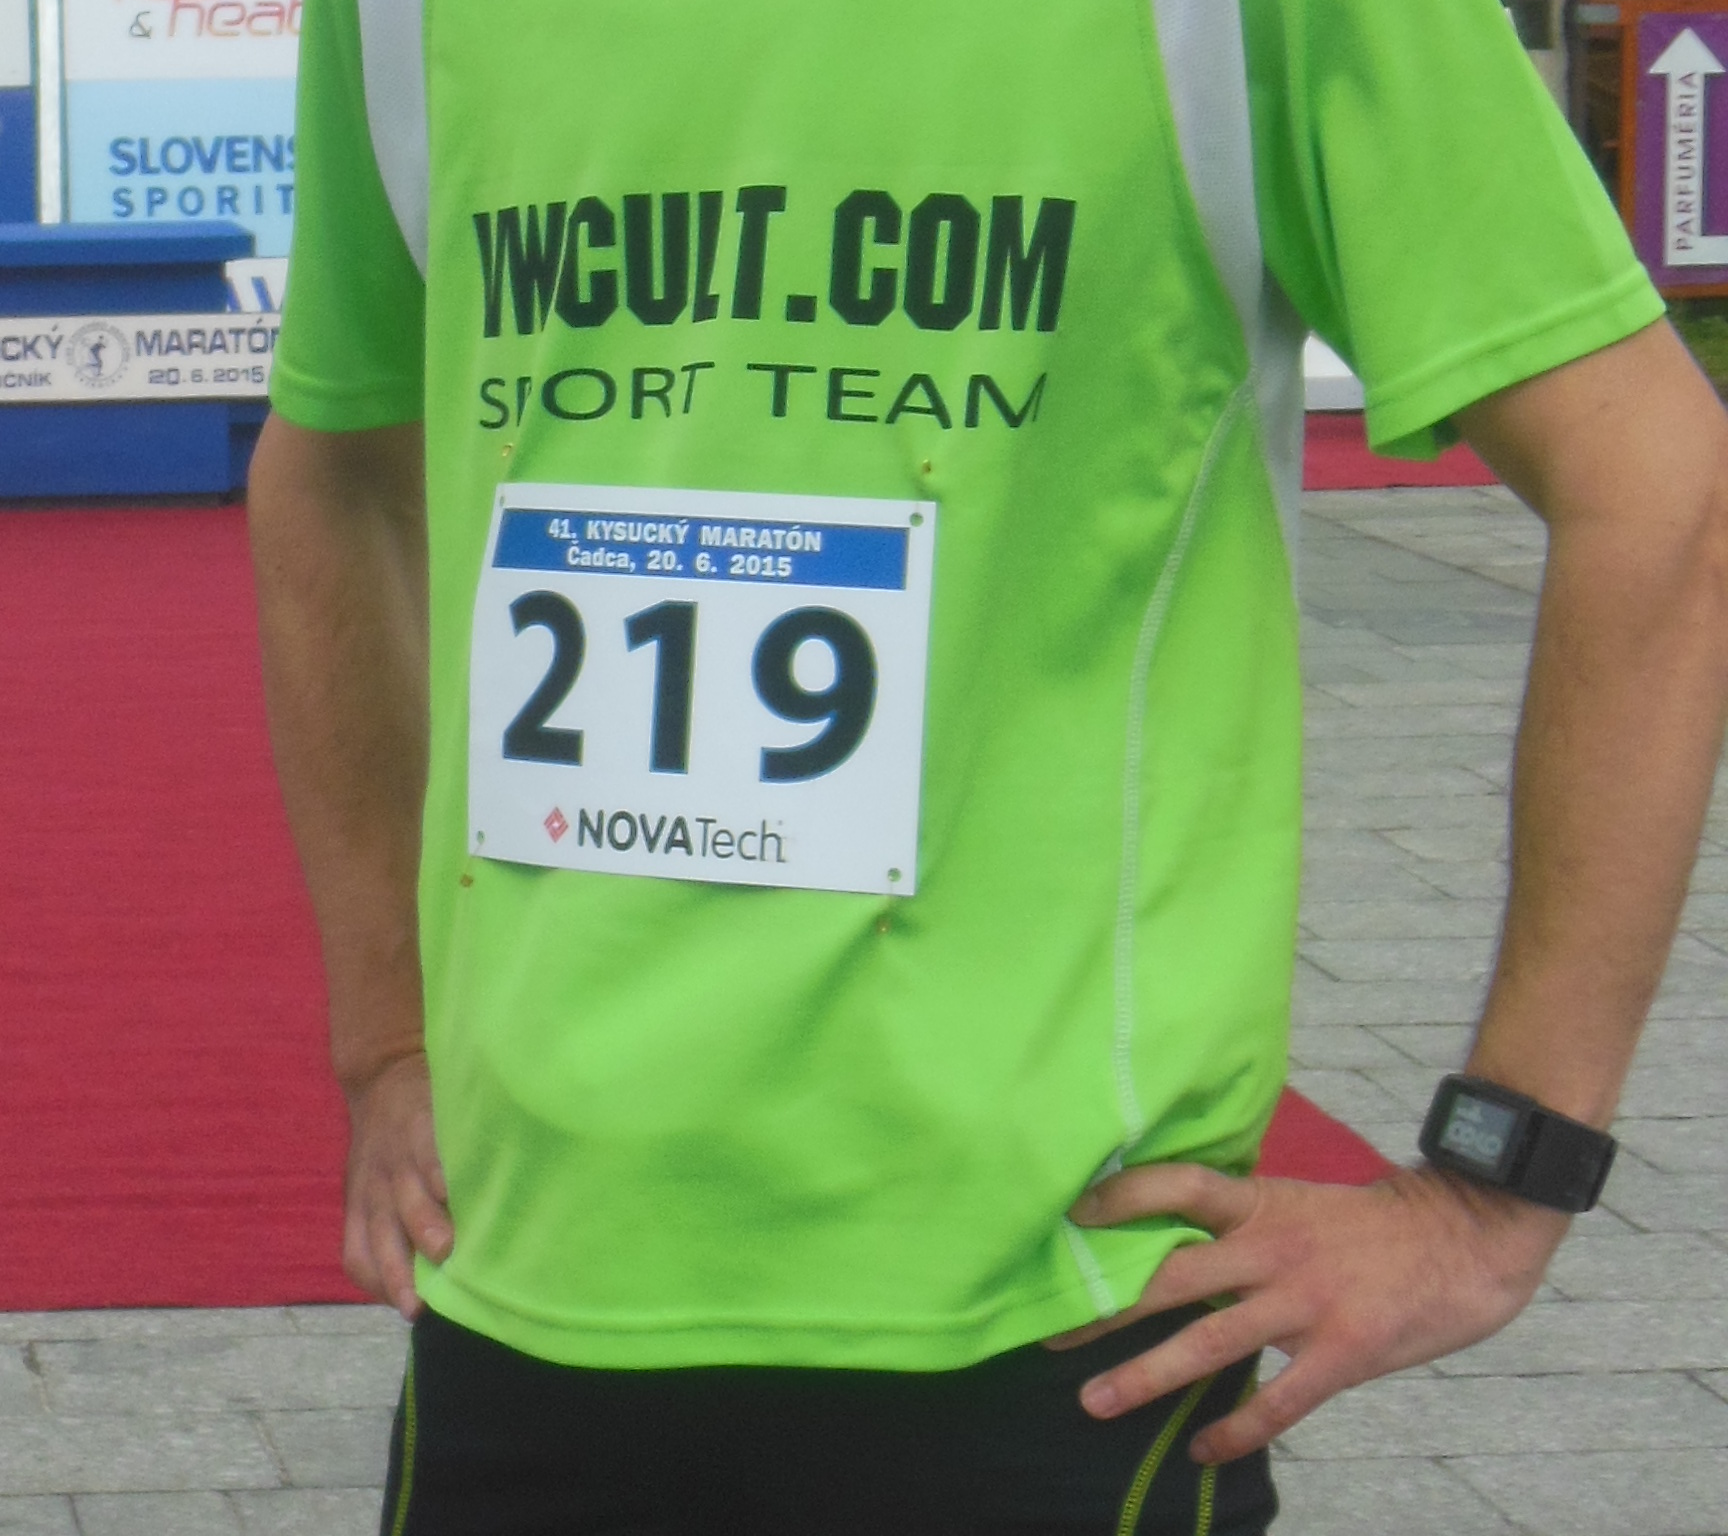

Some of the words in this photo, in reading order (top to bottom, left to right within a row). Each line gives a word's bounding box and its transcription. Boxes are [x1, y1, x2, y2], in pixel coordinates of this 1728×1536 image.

[108, 134, 296, 177] SLOVEN
[112, 183, 294, 219] SPORIT
[148, 364, 265, 386] 20.6.2015
[747, 361, 1049, 432] TEAM
[548, 518, 576, 540] 41.
[587, 518, 691, 546] KYSUCKÝ
[700, 524, 823, 553] MARATÓN
[567, 540, 636, 572] Čadca,
[647, 550, 683, 573] 20.
[696, 552, 718, 574] 6.
[730, 553, 793, 578] 2015
[502, 589, 880, 785] 219
[577, 806, 788, 864] NOVATech
